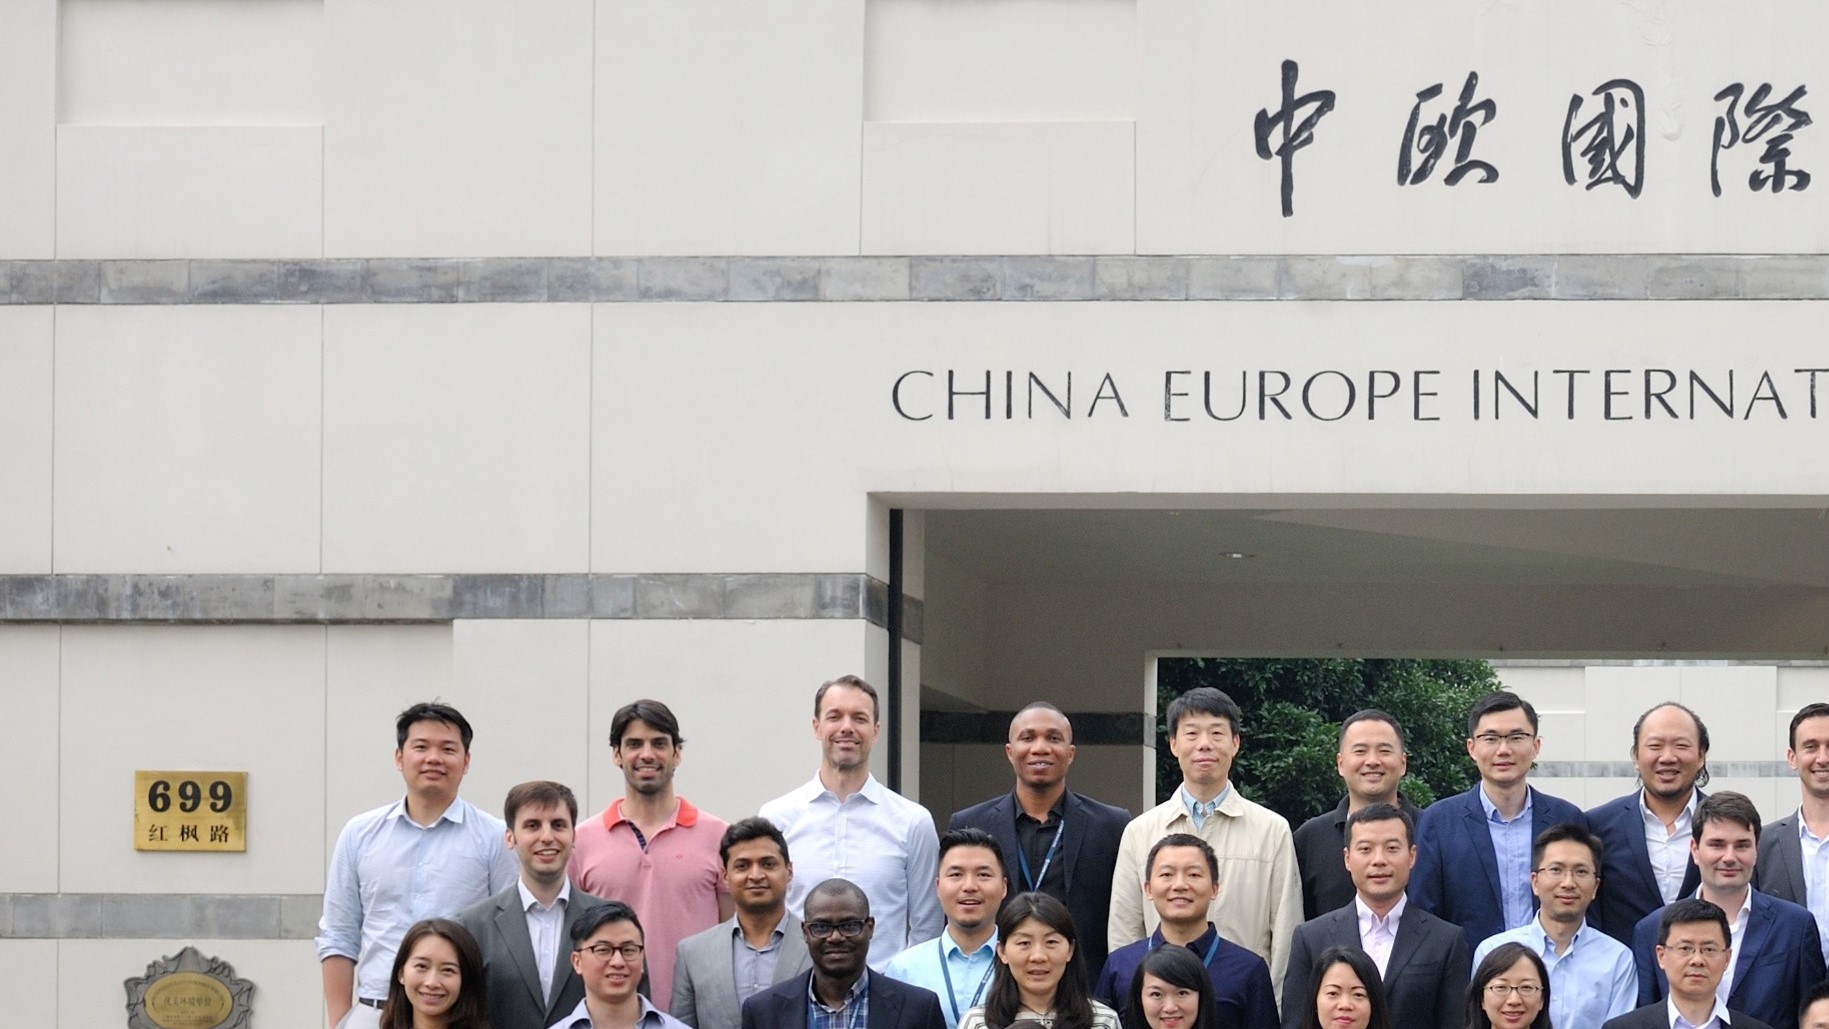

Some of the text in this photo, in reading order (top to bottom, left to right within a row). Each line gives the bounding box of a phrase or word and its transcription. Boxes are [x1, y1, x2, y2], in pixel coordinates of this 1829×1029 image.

[892, 369, 1130, 421] CHINA
[1164, 369, 1442, 422] EUROPE
[148, 780, 233, 813] 699
[148, 823, 229, 843] 红枫路
